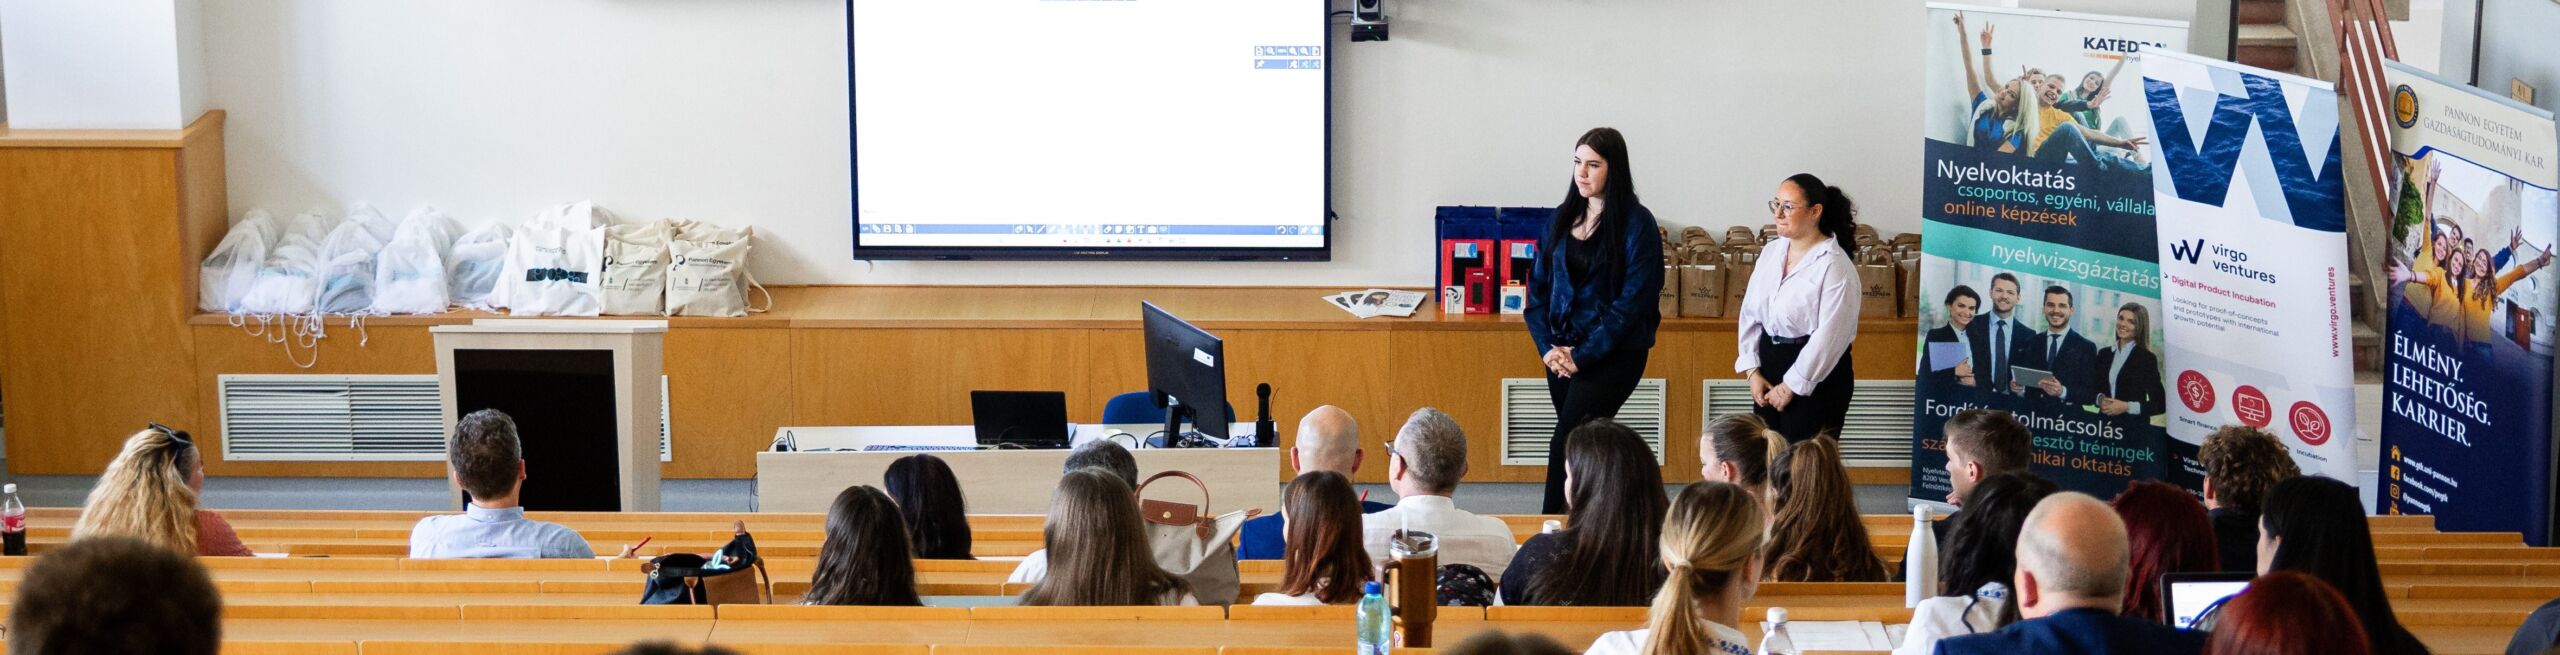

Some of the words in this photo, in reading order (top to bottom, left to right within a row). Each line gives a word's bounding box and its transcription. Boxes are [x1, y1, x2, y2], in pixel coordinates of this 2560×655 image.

[2083, 36, 2163, 53] KATED
[2444, 105, 2481, 127] PANNON
[2483, 118, 2522, 142] EGYETEM
[2423, 116, 2522, 161] GAZDASÁGTUDOMÁNYI
[2525, 152, 2545, 169] KAR
[1937, 159, 2076, 191] Nyelvoktatás
[1958, 184, 2040, 205] csoportos,
[2044, 193, 2101, 213] egyéni,
[1944, 201, 1996, 218] online
[2001, 203, 2077, 226] képzések
[1991, 243, 2159, 290] nyelvvizsgáztatás
[2211, 243, 2248, 262] virgo
[2212, 260, 2277, 284] ventures
[2171, 275, 2197, 288] Digital
[2198, 283, 2231, 297] Product
[2232, 290, 2276, 308] Incubation
[2172, 296, 2198, 308] Looking
[2198, 301, 2208, 310] for
[2209, 305, 2268, 325] proof-of-concepts
[2173, 305, 2185, 313] and
[2185, 308, 2222, 322] prototypes
[2222, 317, 2237, 326] with
[2237, 320, 2280, 337] international
[2173, 313, 2196, 325] growth
[2196, 319, 2226, 332] potential
[2327, 266, 2339, 358] www.virgo.ventures
[2393, 329, 2464, 383] ÉLMÉNY.
[2392, 362, 2492, 426] LEHETŐSÉG.
[2179, 415, 2196, 425] Smart
[2196, 421, 2218, 431] finance
[2392, 391, 2472, 447] KARRIER.
[2079, 438, 2155, 463] tréningek
[2296, 448, 2328, 463] Incubation
[1922, 474, 1938, 483] 8200
[2071, 455, 2132, 477] oktatás
